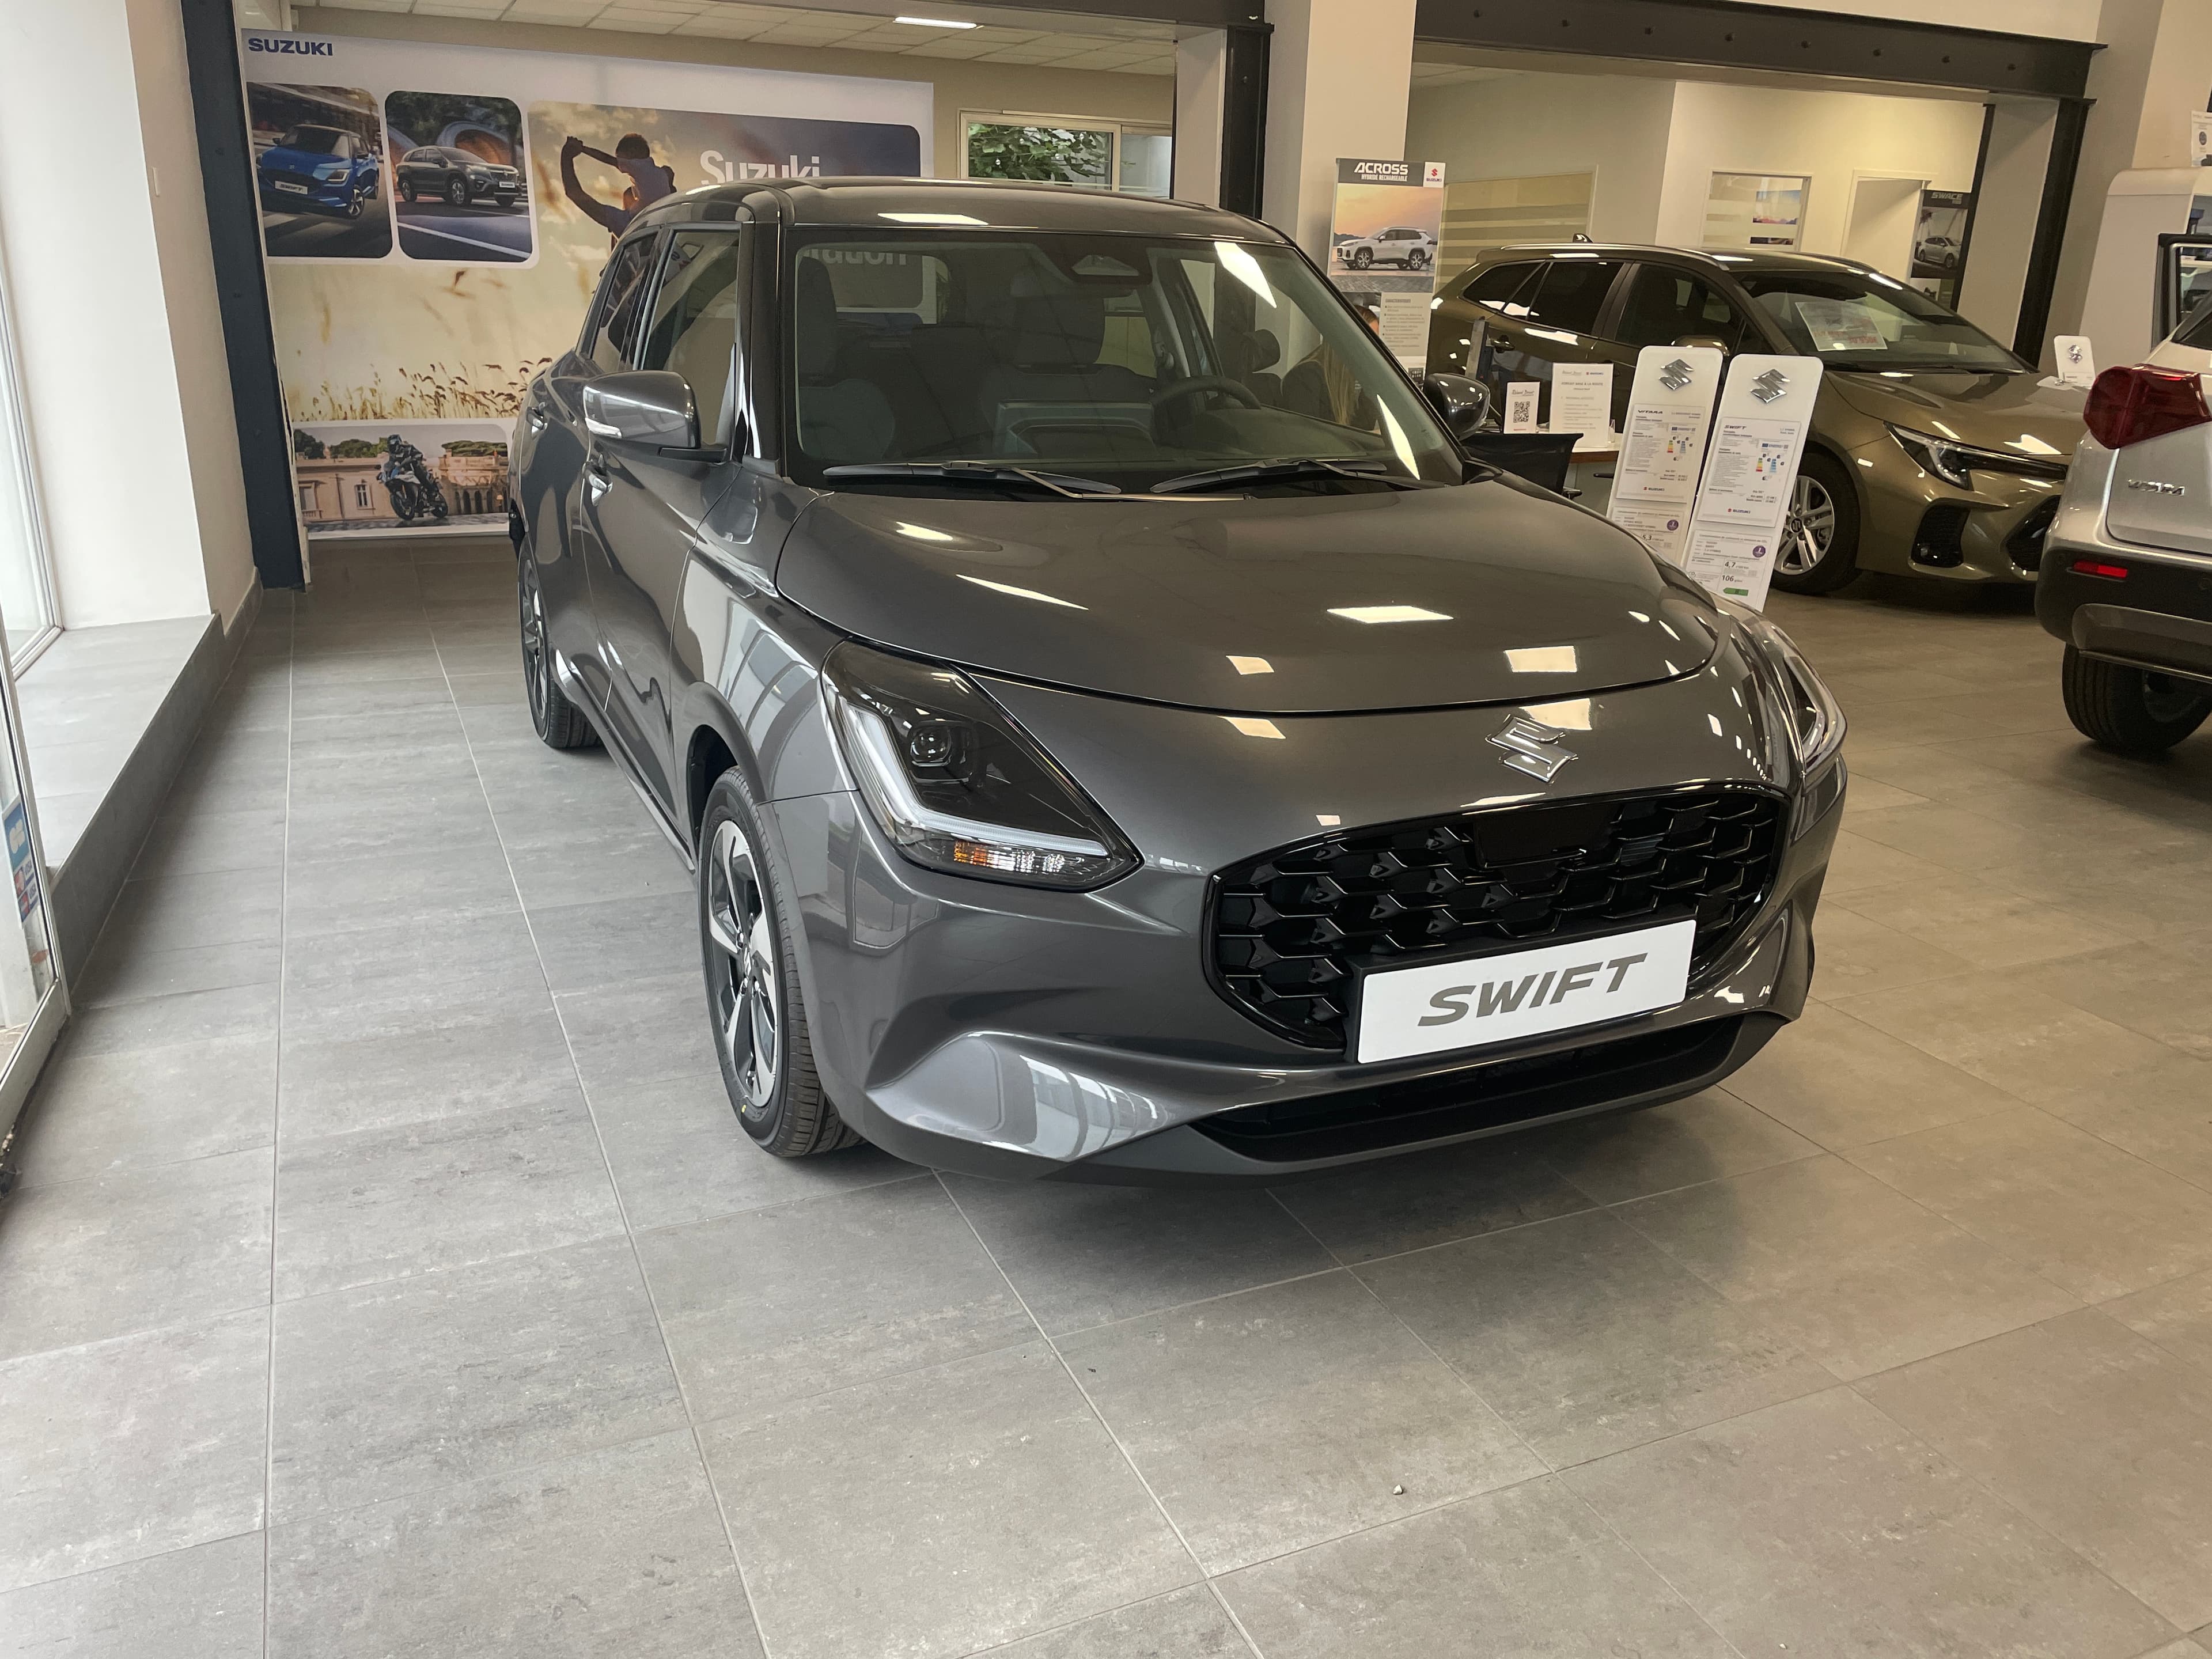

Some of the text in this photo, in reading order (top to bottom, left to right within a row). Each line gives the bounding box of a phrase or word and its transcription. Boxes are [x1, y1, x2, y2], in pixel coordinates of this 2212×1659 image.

[248, 37, 333, 56] SUZUKI
[1354, 162, 1408, 175] ACROSS
[1930, 192, 1963, 200] SWACE
[1418, 953, 1648, 1027] SWIFT
